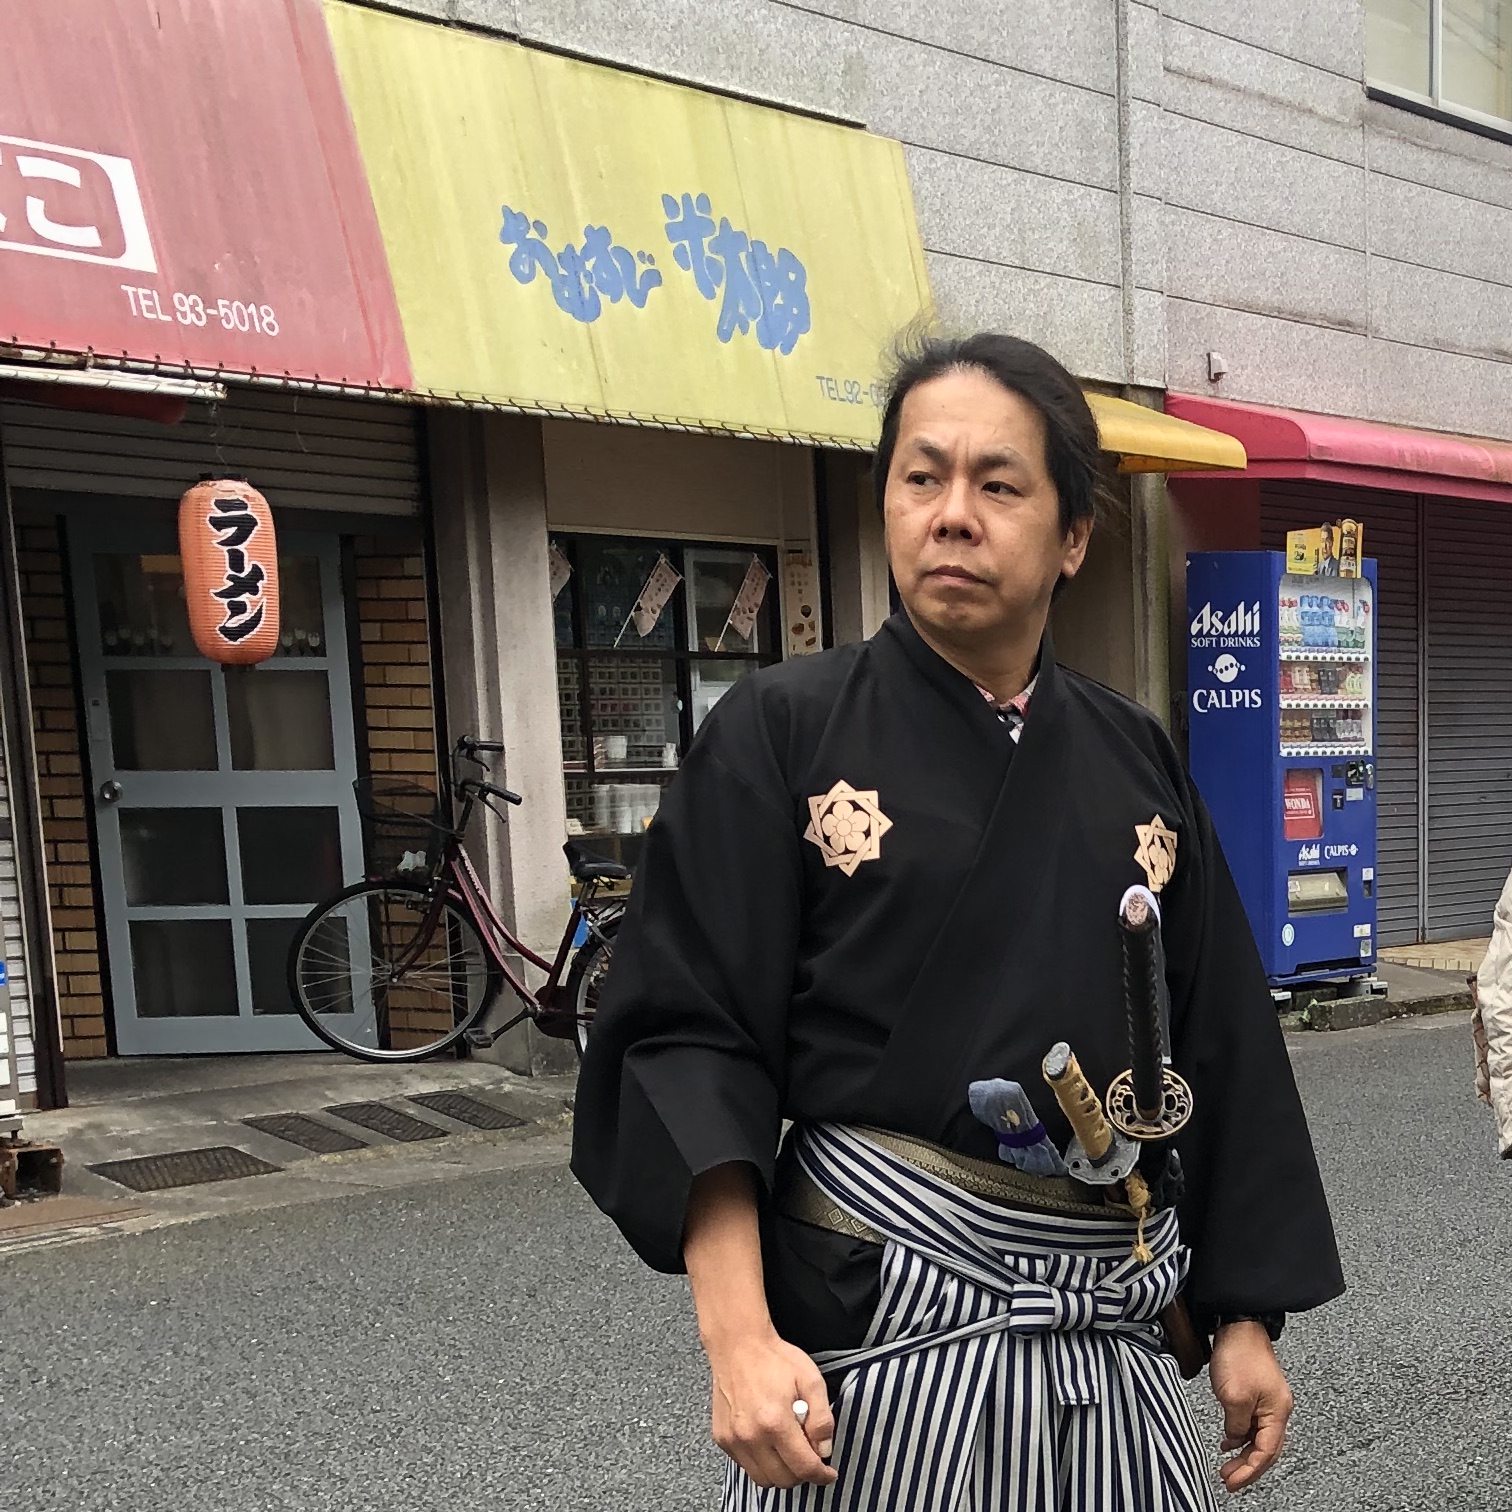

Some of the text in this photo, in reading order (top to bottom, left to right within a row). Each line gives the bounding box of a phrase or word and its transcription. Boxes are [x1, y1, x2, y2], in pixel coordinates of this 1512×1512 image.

[0, 152, 103, 248] こ
[120, 284, 279, 336] TEL 93-5018
[207, 498, 266, 643] ラーメン
[1190, 600, 1261, 636] Asahi
[1191, 636, 1261, 648] SOFT DRINKS
[1193, 688, 1262, 713] CALPIS
[1285, 798, 1311, 810] WONDA
[1324, 844, 1349, 859] CALPIS
